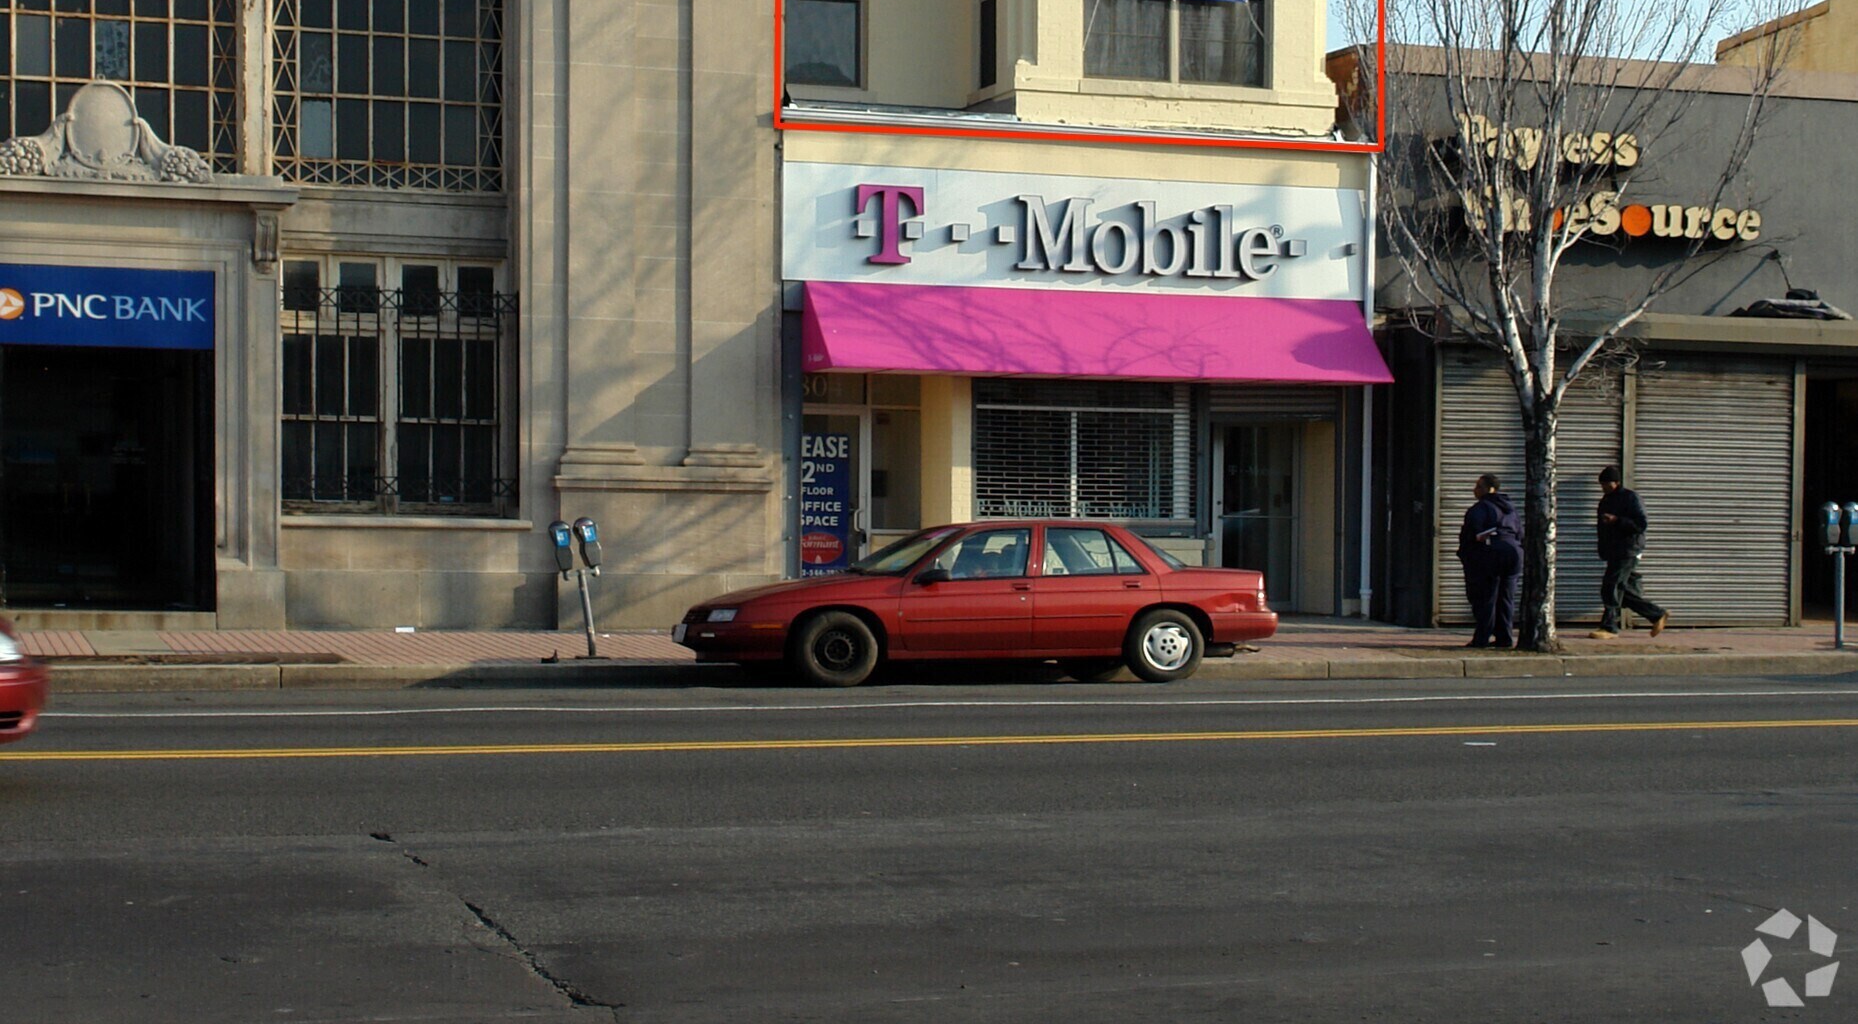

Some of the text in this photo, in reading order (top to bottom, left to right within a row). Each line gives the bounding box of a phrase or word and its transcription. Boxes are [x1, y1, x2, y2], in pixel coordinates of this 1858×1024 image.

[1458, 113, 1639, 171] Payess
[1465, 184, 1762, 242] heSource
[30, 292, 206, 322] PNC BANK
[801, 436, 848, 458] EASE
